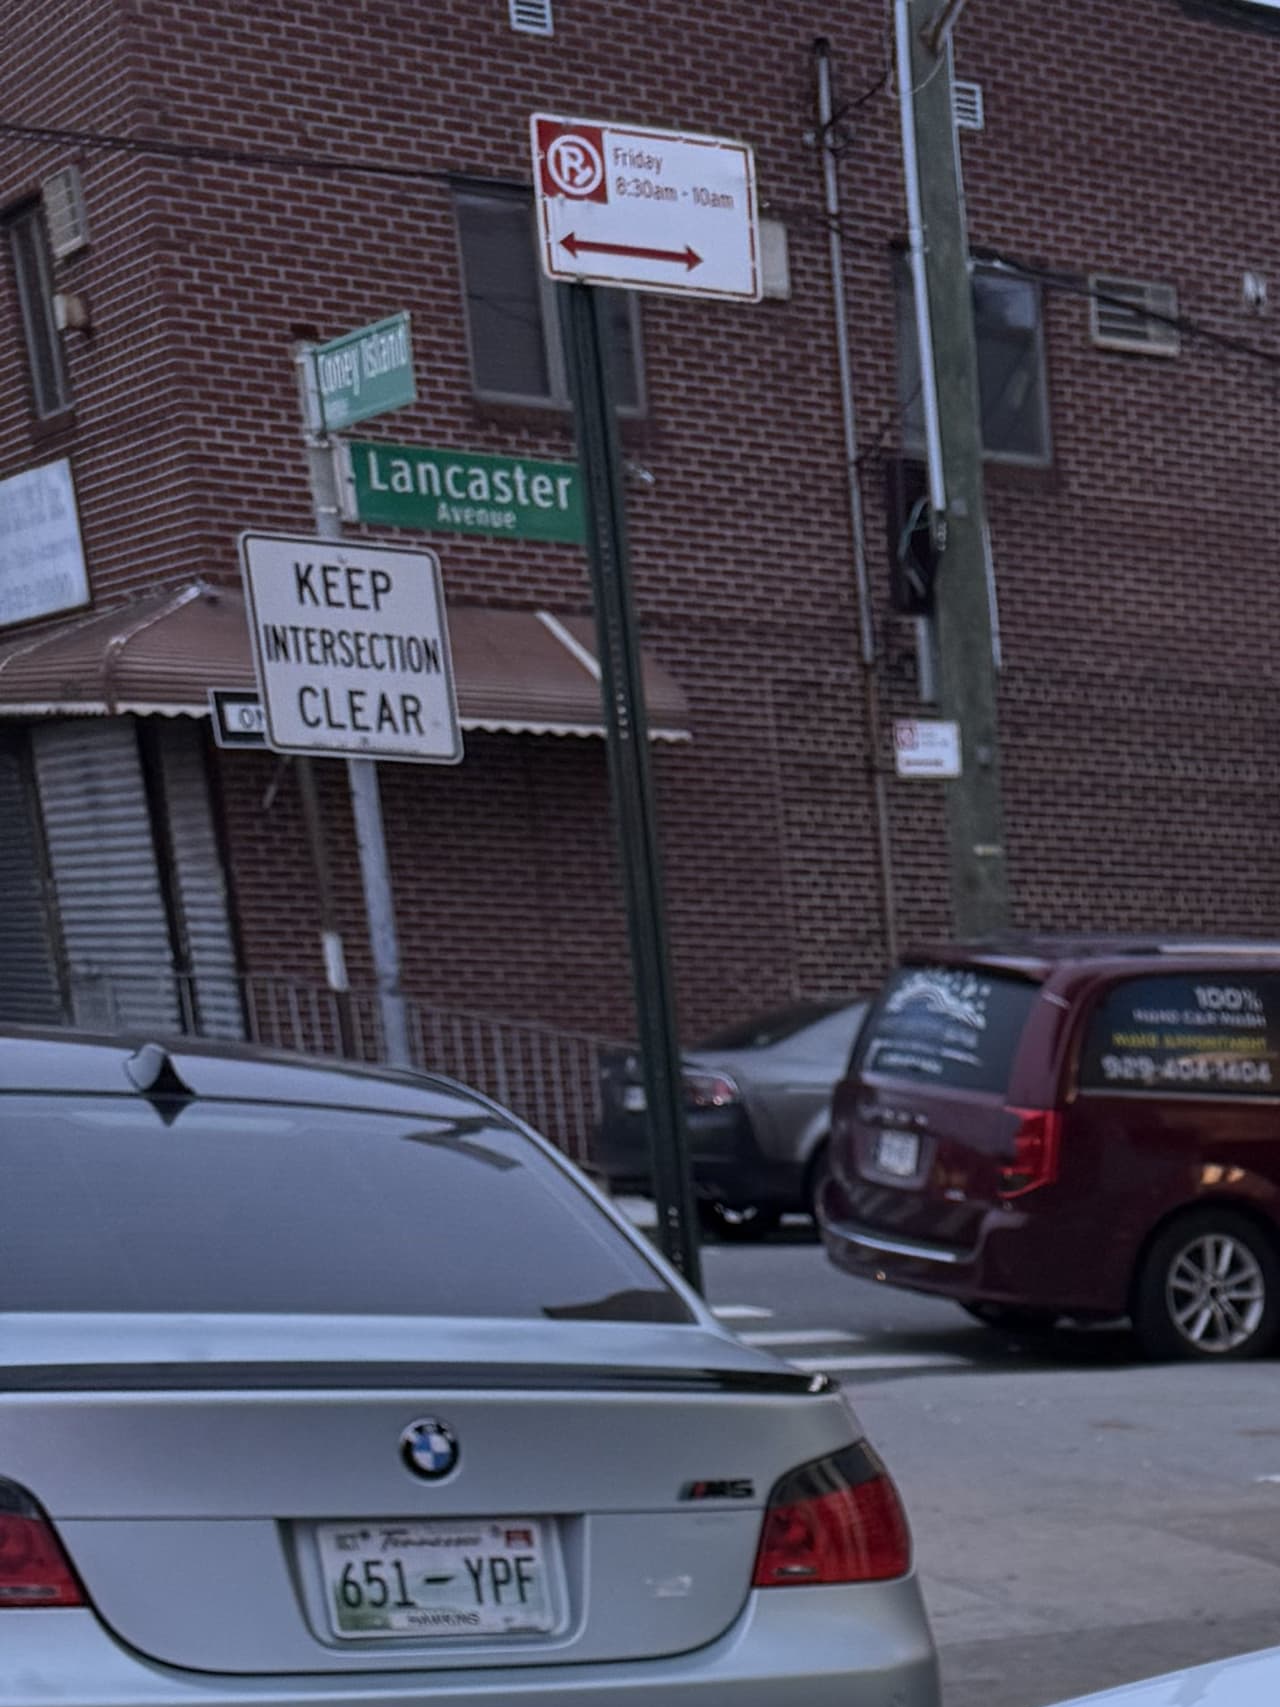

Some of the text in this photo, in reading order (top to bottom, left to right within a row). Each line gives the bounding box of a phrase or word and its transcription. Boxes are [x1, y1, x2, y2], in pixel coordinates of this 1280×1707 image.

[613, 147, 663, 174] Friday
[615, 176, 678, 201] 8:30am
[692, 185, 735, 209] 10am
[368, 450, 573, 511] Lancaster
[437, 501, 517, 530] Avenue
[294, 561, 393, 611] KEEP
[262, 623, 442, 675] INTERSECTION
[298, 685, 426, 736] CLEAR
[1194, 985, 1263, 1012] 100%
